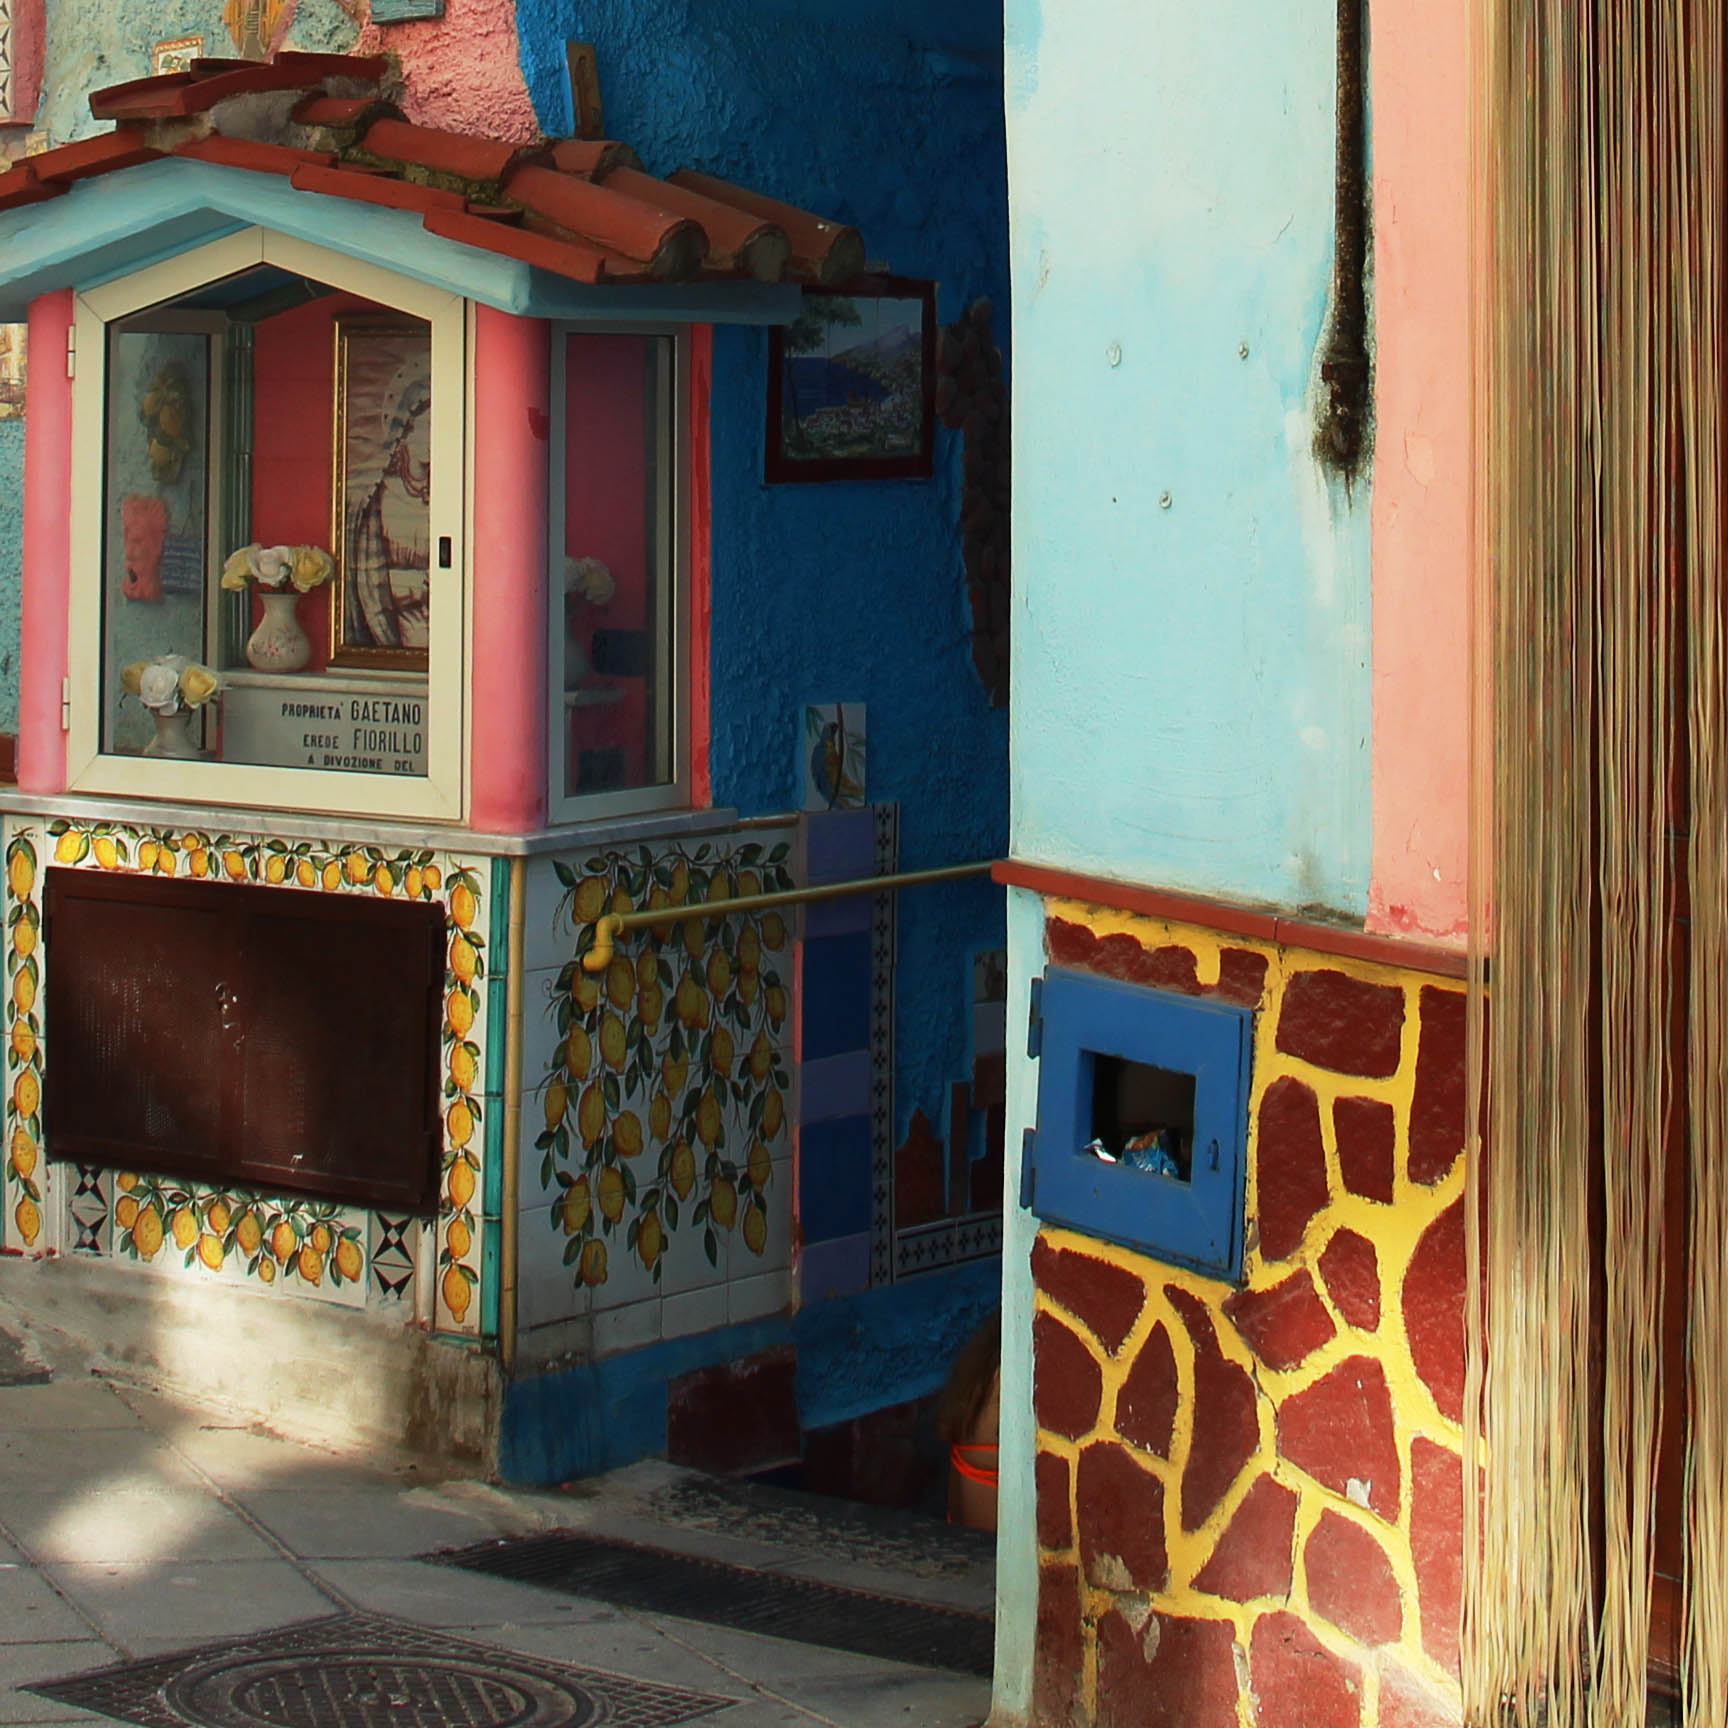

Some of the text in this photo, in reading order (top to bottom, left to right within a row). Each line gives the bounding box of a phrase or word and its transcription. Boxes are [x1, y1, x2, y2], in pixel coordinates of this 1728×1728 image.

[351, 700, 422, 725] GAETANO
[303, 728, 422, 754] EREDE FIORILLO
[307, 753, 415, 773] A DIVOZIONE DEL
